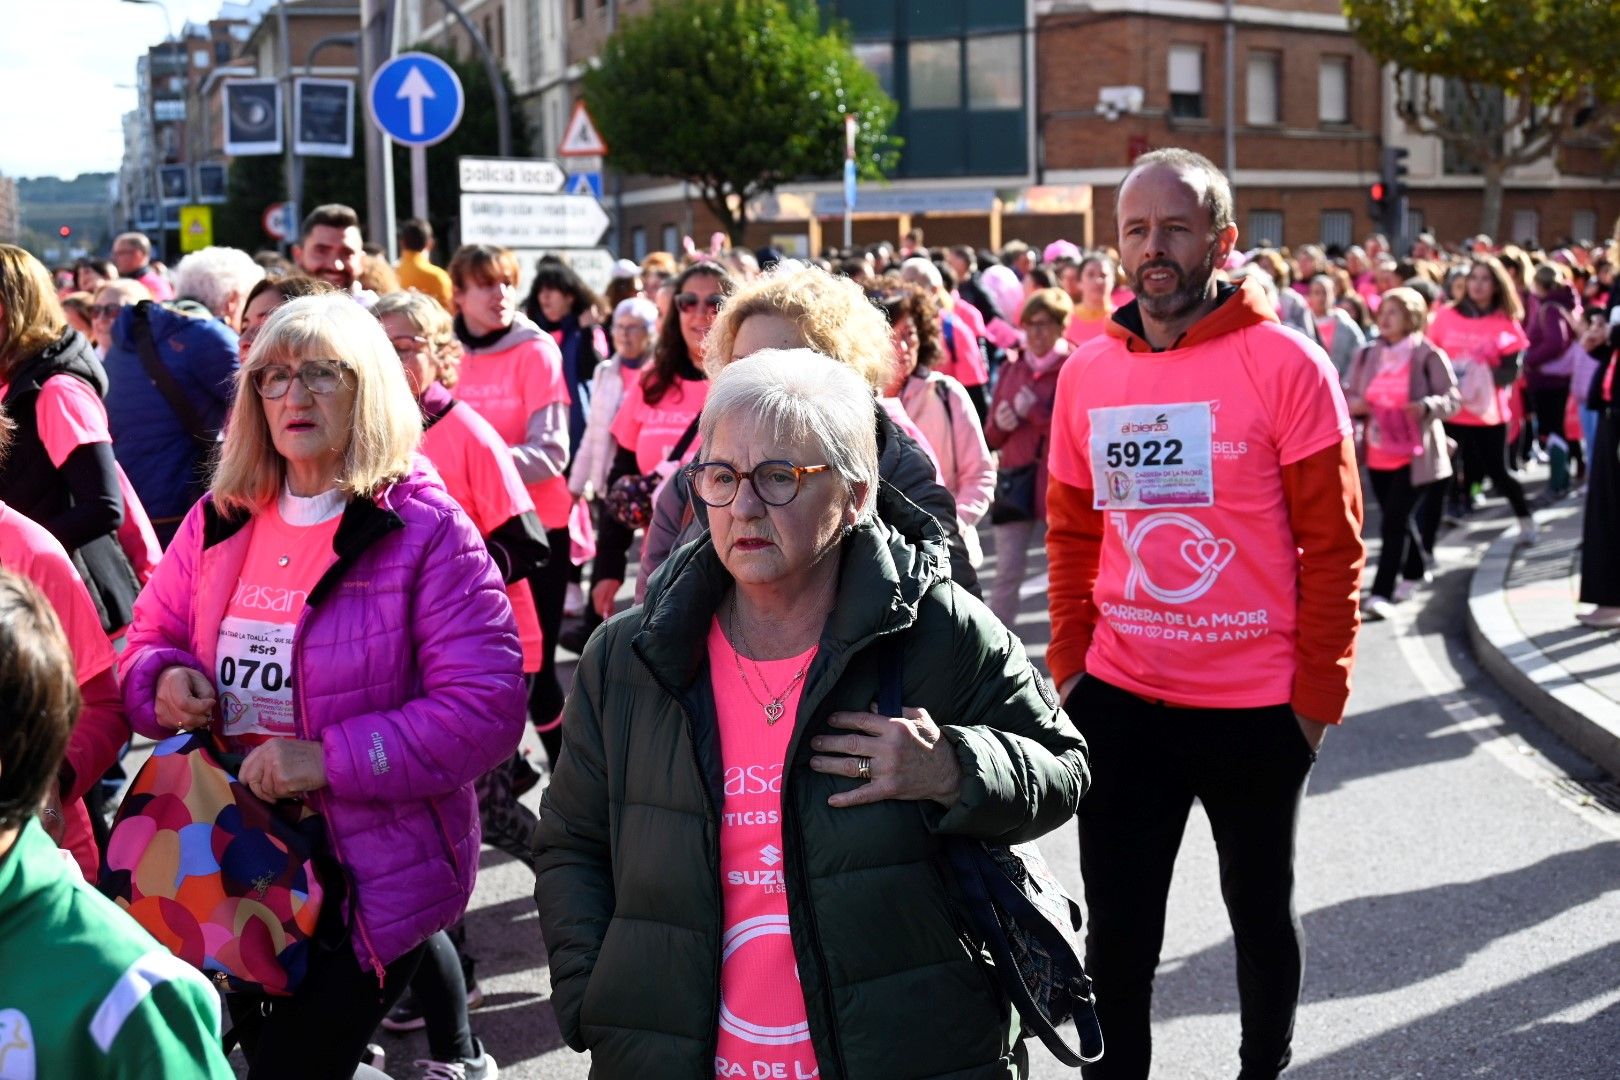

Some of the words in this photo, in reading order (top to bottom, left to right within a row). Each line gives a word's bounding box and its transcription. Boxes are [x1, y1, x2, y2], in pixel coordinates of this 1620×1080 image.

[1106, 439, 1184, 468] 5922
[1101, 602, 1164, 624] CARRERA
[1165, 611, 1185, 626] DE
[1187, 614, 1208, 628] LA
[1211, 609, 1269, 628] MUJER
[249, 644, 277, 656] #Sr9
[371, 731, 389, 775] climatek
[752, 1060, 788, 1080] DE
